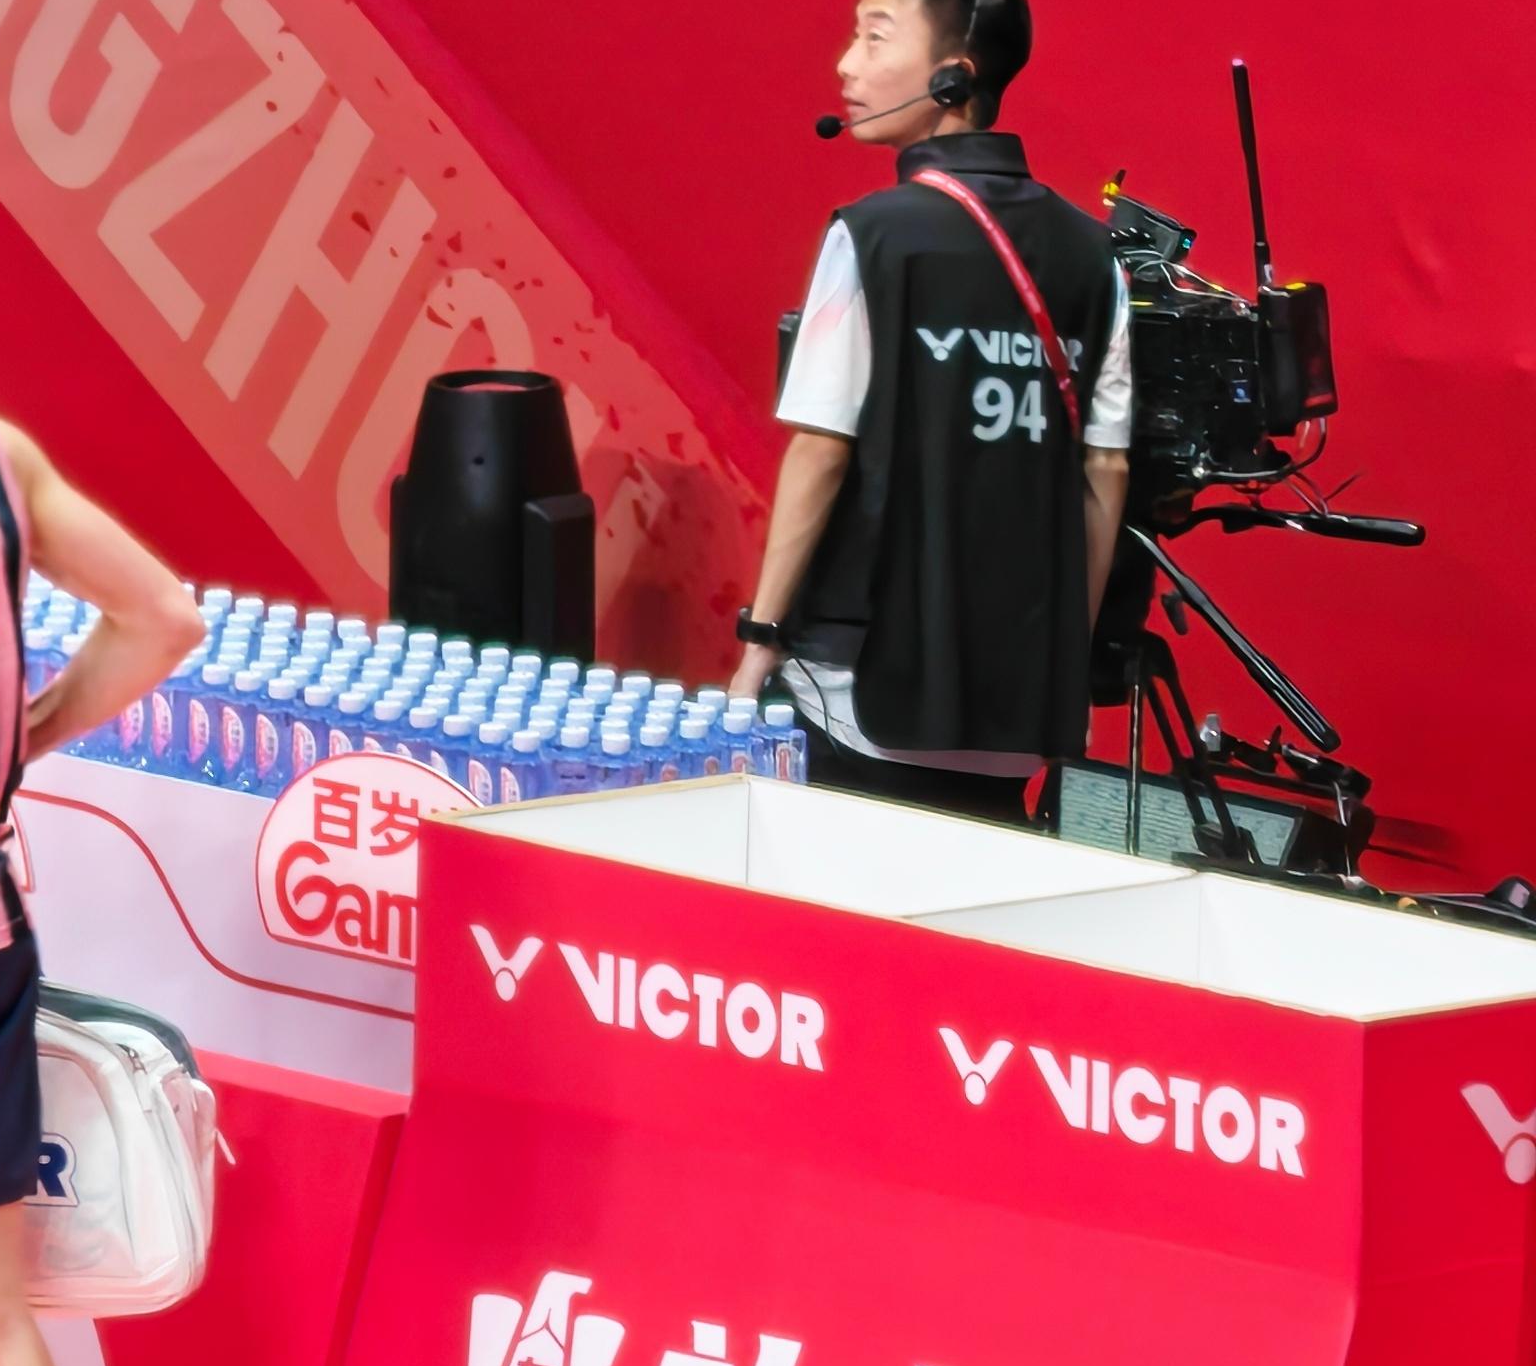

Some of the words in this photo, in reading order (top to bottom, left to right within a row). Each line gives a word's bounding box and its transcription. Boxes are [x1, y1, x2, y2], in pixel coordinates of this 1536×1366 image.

[972, 376, 1048, 444] 94
[313, 777, 439, 857] 百岁
[556, 941, 826, 1073] VICTOR
[1027, 1045, 1307, 1178] VICTOR
